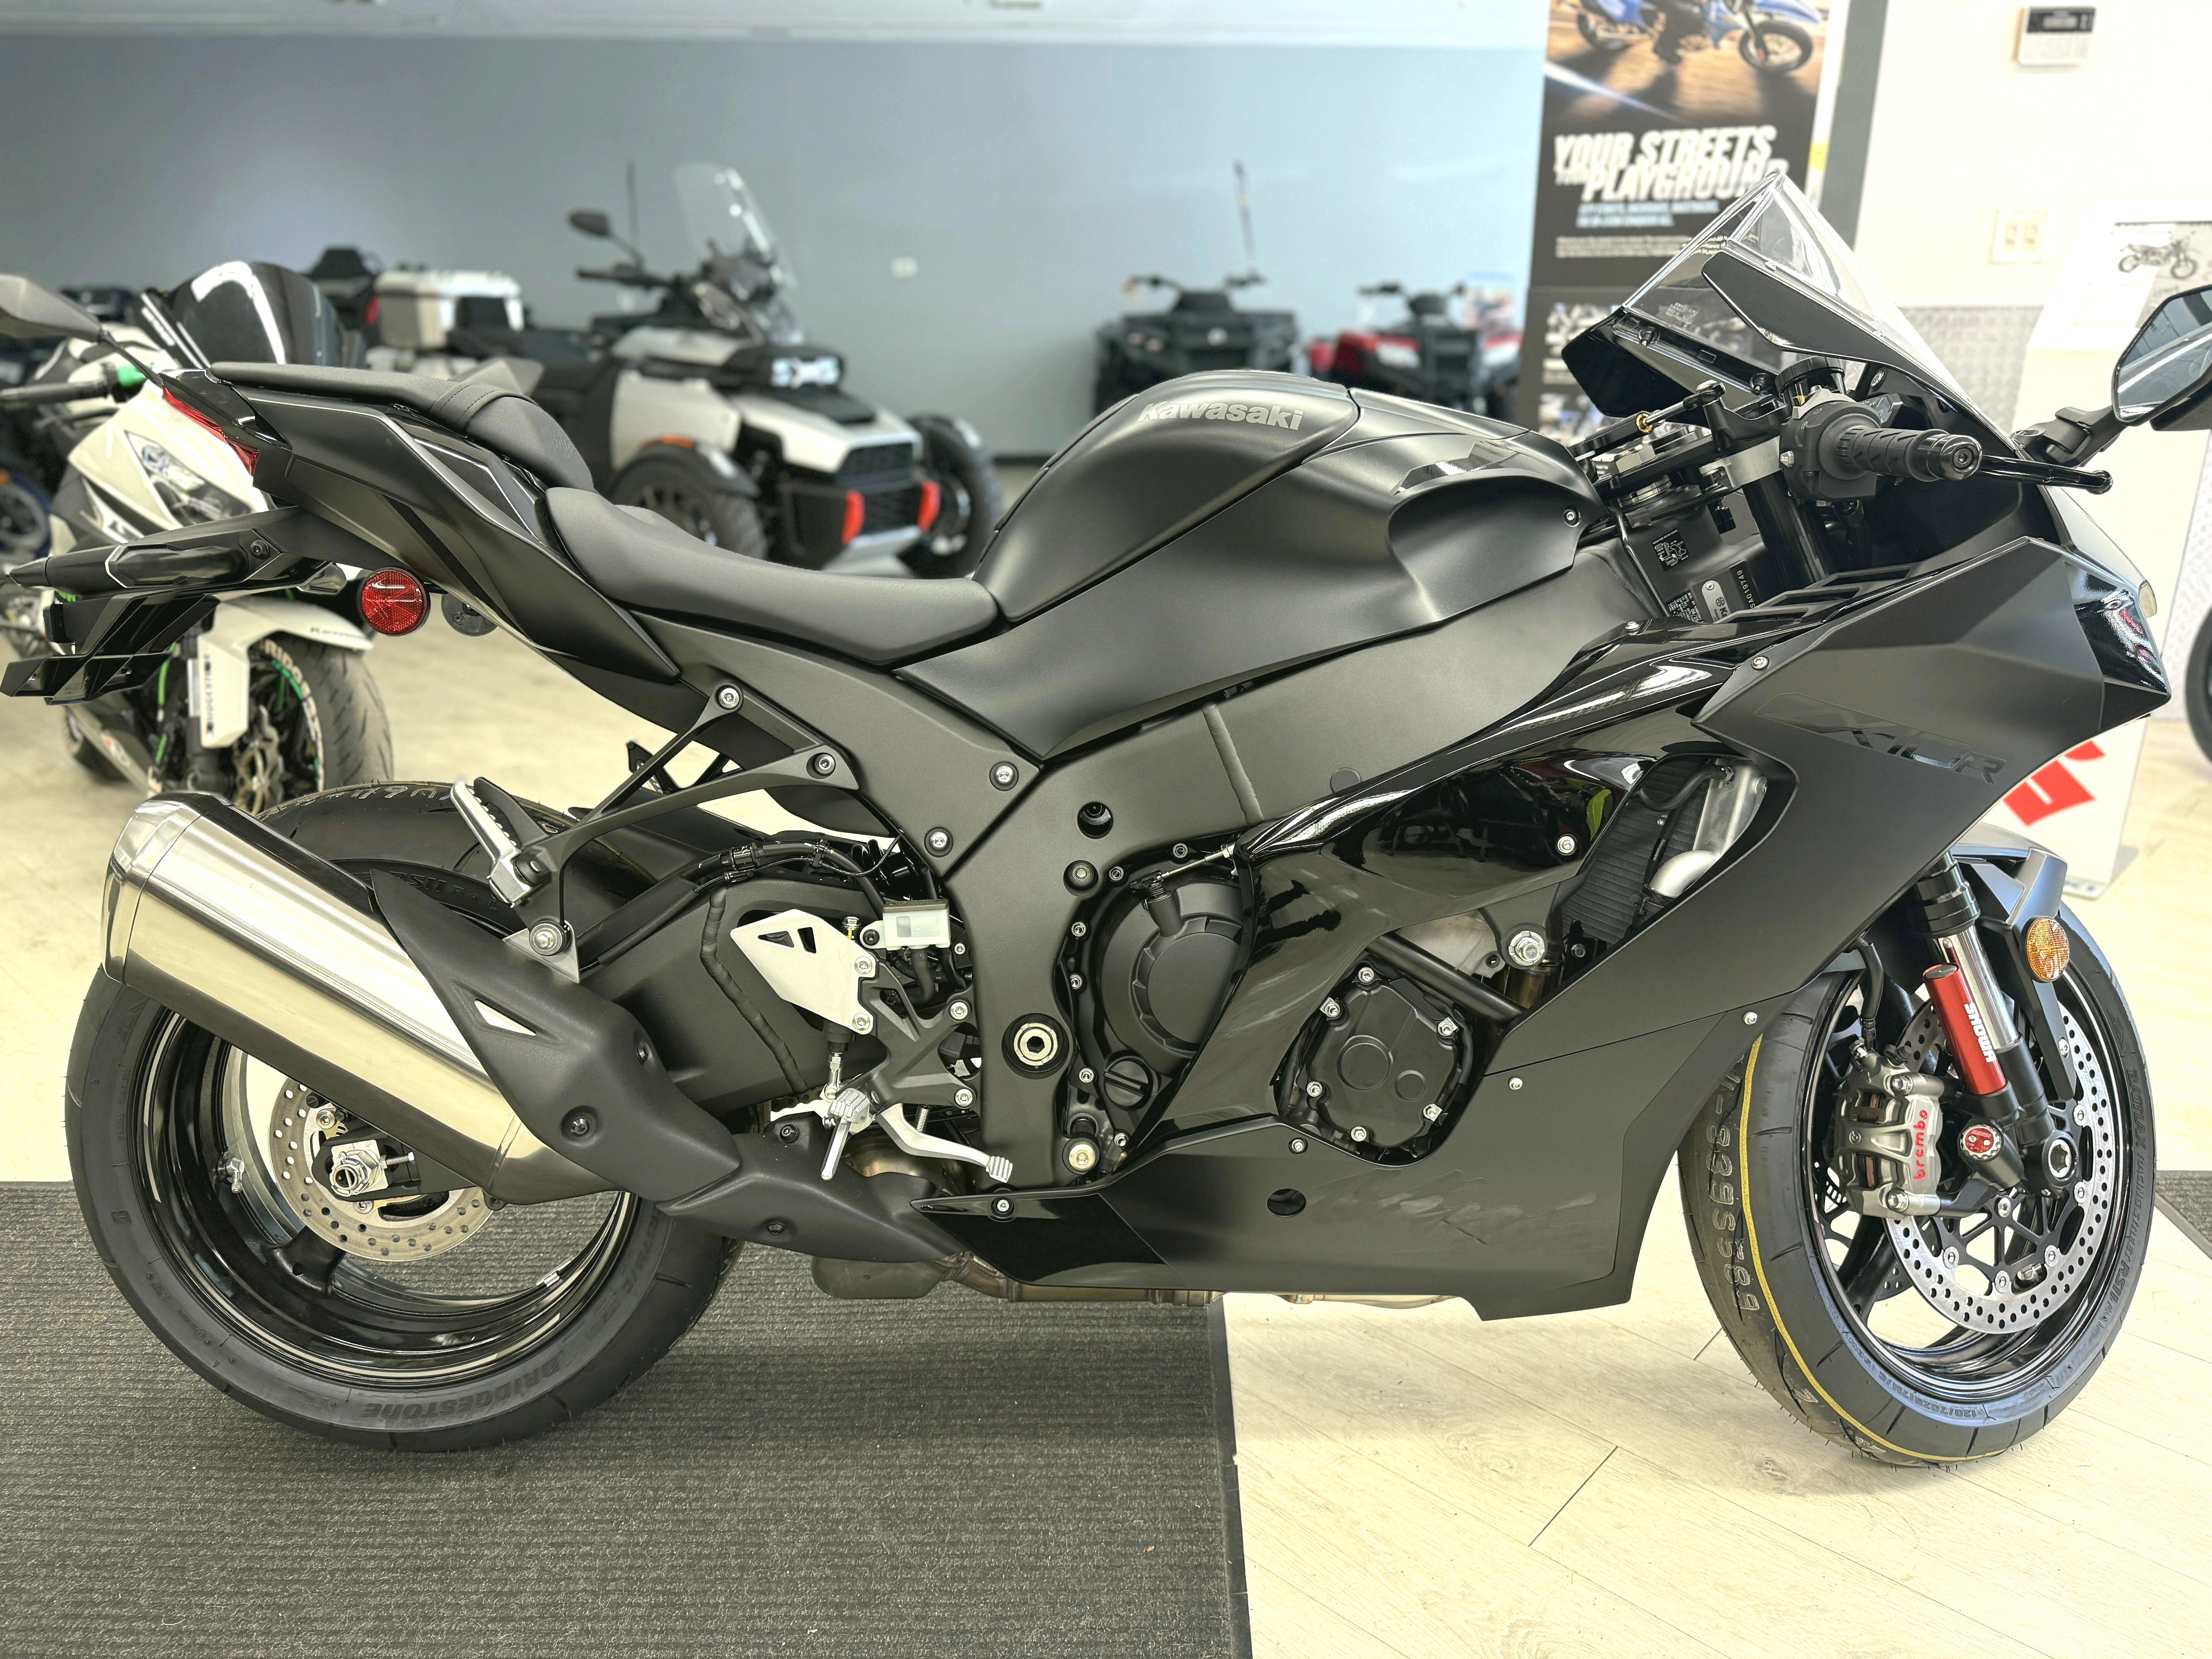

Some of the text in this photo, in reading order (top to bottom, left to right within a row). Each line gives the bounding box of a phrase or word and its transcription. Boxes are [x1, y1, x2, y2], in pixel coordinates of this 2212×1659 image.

[1554, 125, 1777, 170] YOUR STREETS
[1137, 401, 1303, 430] Kawasaki
[1964, 1002, 1996, 1063] SHOWA
[2126, 1069, 2148, 1150] BATTLAX
[1913, 1109, 1928, 1181] brembo
[2134, 1152, 2145, 1207] RACING
[2124, 1207, 2142, 1262] STREET
[362, 1353, 560, 1420] BRIDGESTONE
